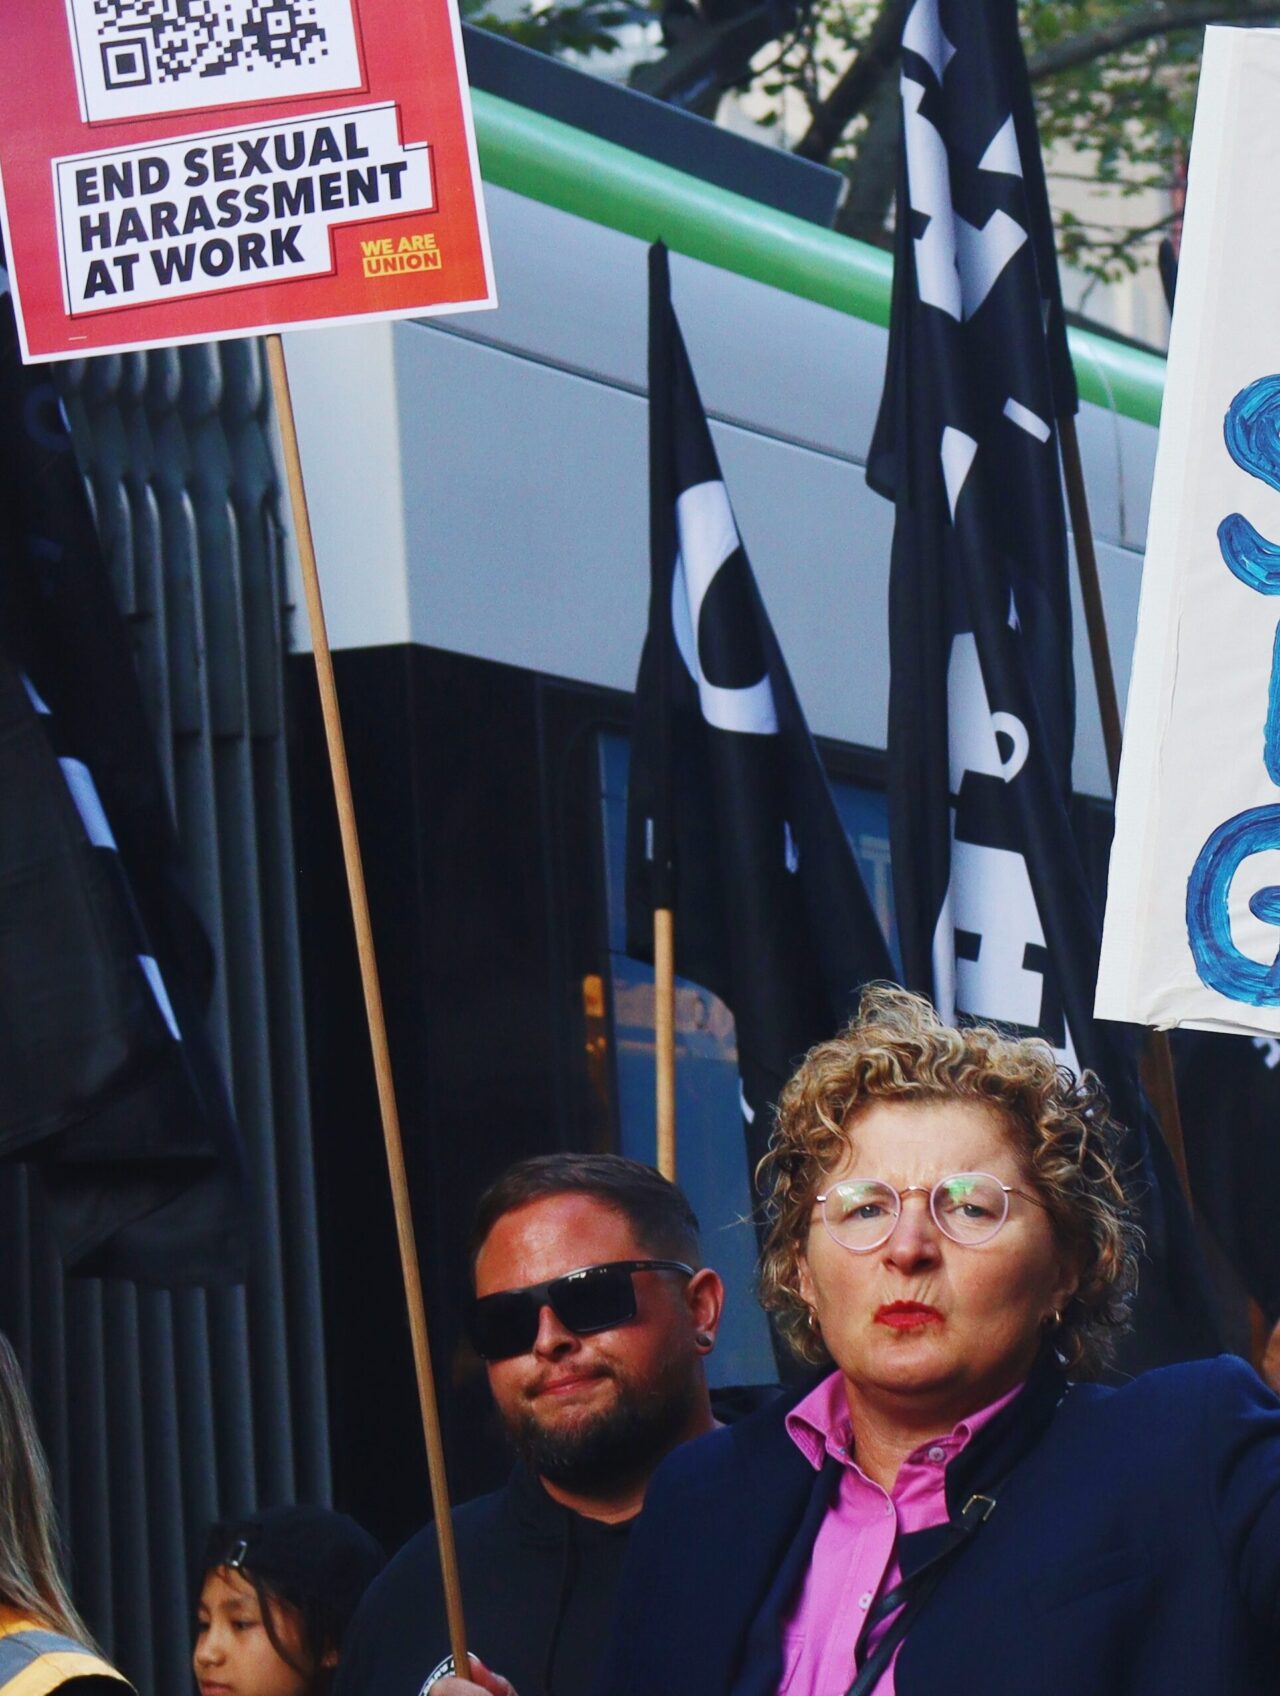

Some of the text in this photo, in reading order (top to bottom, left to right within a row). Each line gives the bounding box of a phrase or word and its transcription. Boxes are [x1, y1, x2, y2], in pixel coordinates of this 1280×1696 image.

[75, 122, 369, 206] END SEXUAL
[79, 161, 408, 252] HARASSMENT
[83, 225, 305, 300] AT WORK
[360, 233, 437, 257] WE ARE
[366, 251, 438, 275] UNION
